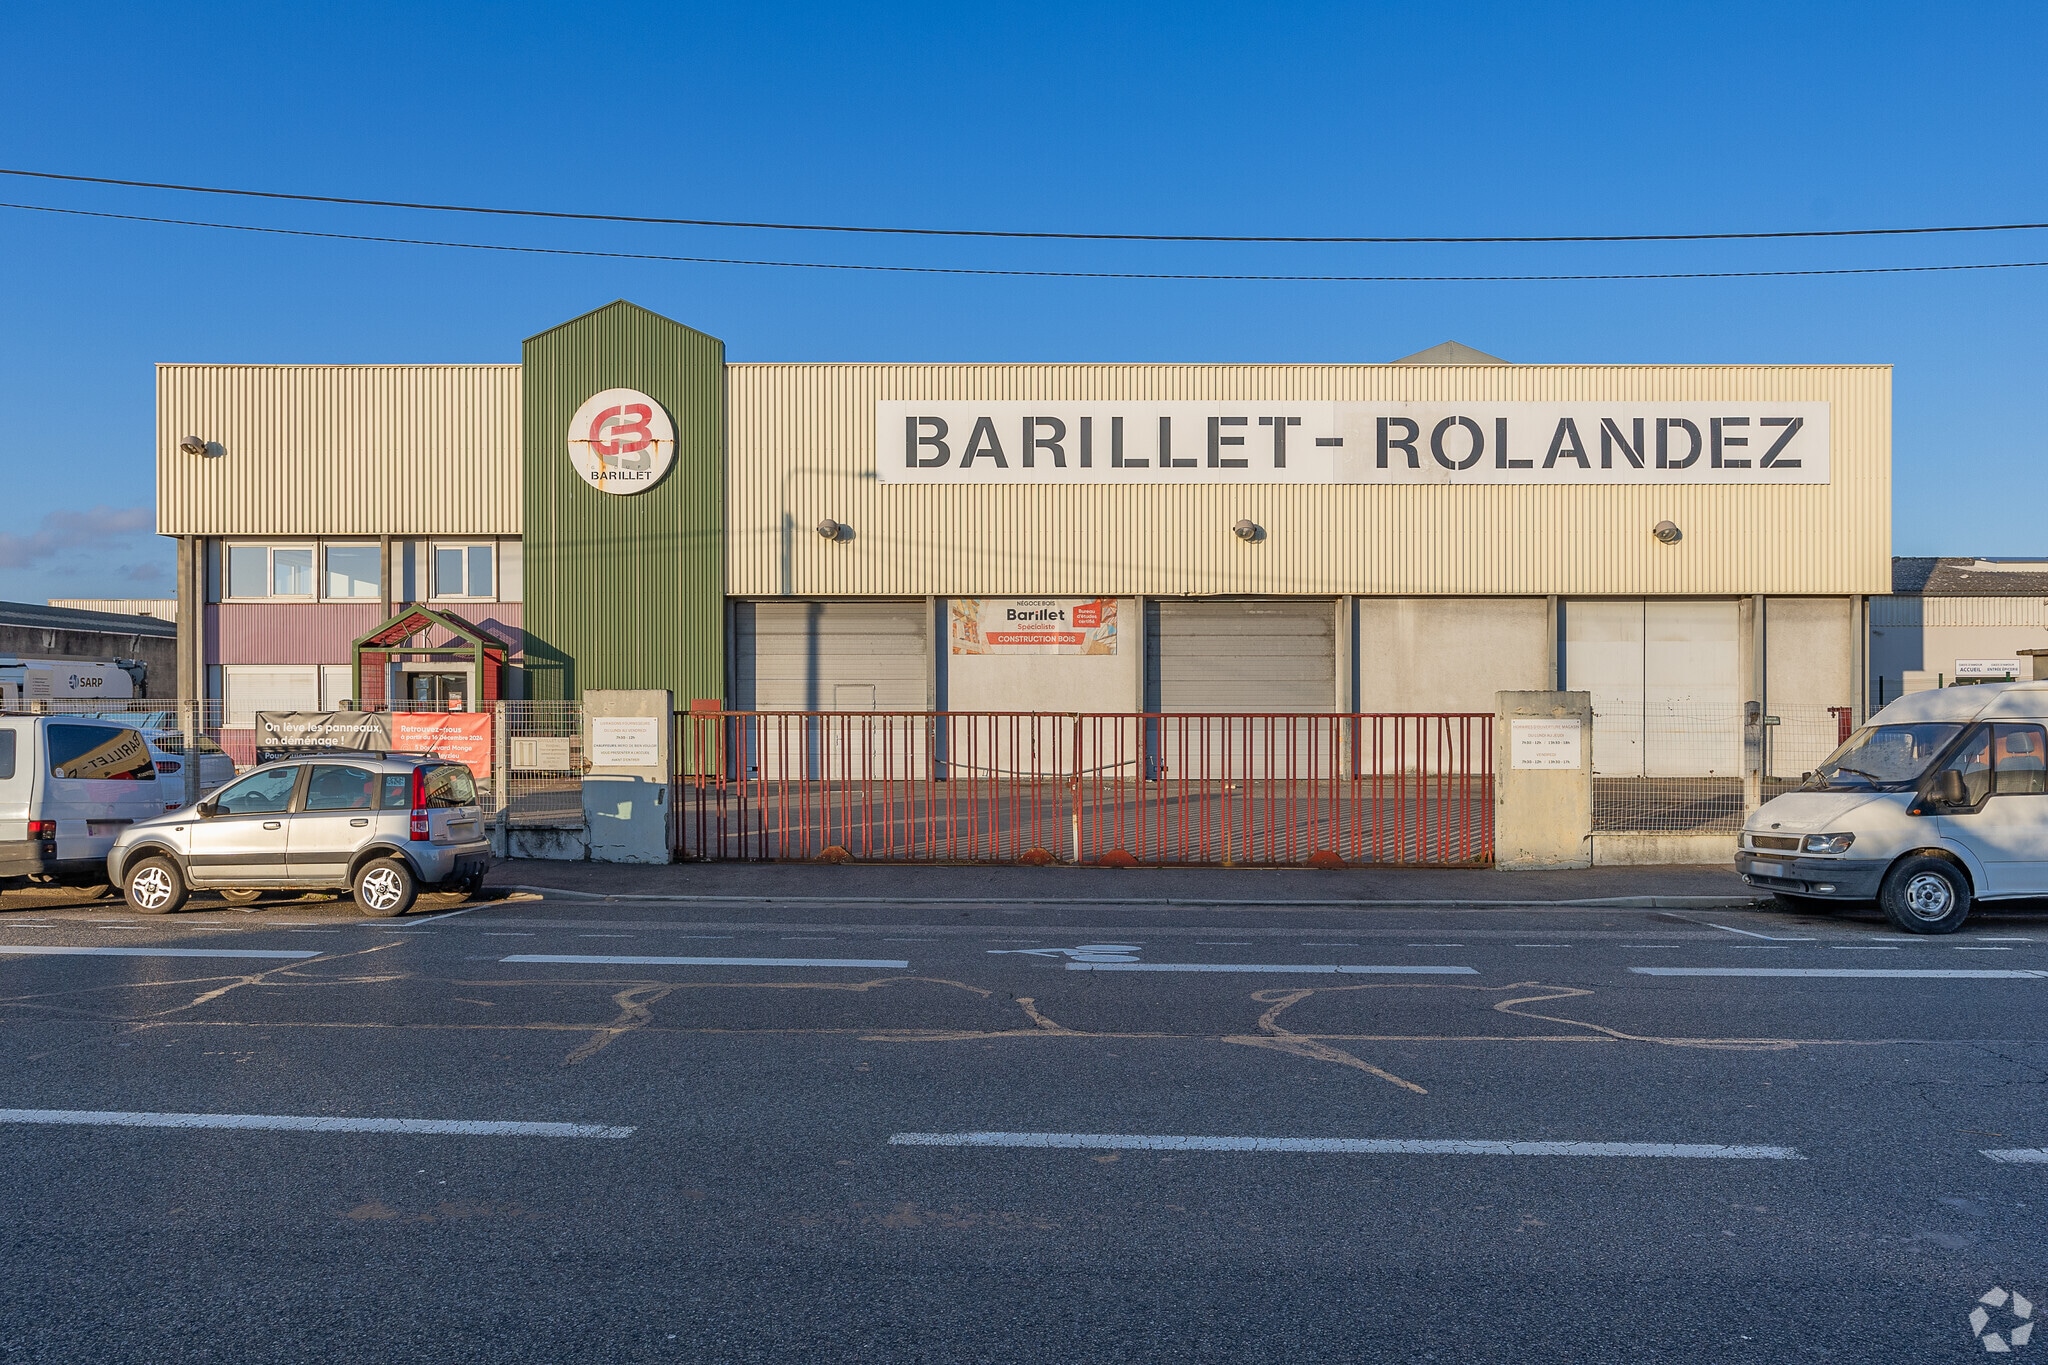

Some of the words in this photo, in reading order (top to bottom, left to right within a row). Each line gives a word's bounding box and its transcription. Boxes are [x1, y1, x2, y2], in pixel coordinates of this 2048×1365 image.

[905, 416, 1301, 468] BARILLET
[1376, 415, 1804, 470] ROLANDEZ
[591, 471, 652, 480] BARILLET
[1006, 608, 1065, 621] Barillet
[1017, 623, 1056, 631] Spécialiste
[997, 635, 1057, 643] CONSTRUCTION
[1058, 635, 1076, 643] BOIS
[80, 677, 103, 688] SARP
[265, 722, 280, 732] On
[283, 722, 305, 732] lève
[307, 722, 323, 732] les
[325, 724, 383, 734] panneaux,
[401, 725, 462, 733] Retrouvez-nous
[265, 738, 280, 746] on
[280, 736, 339, 748] déménage
[341, 736, 345, 746] !
